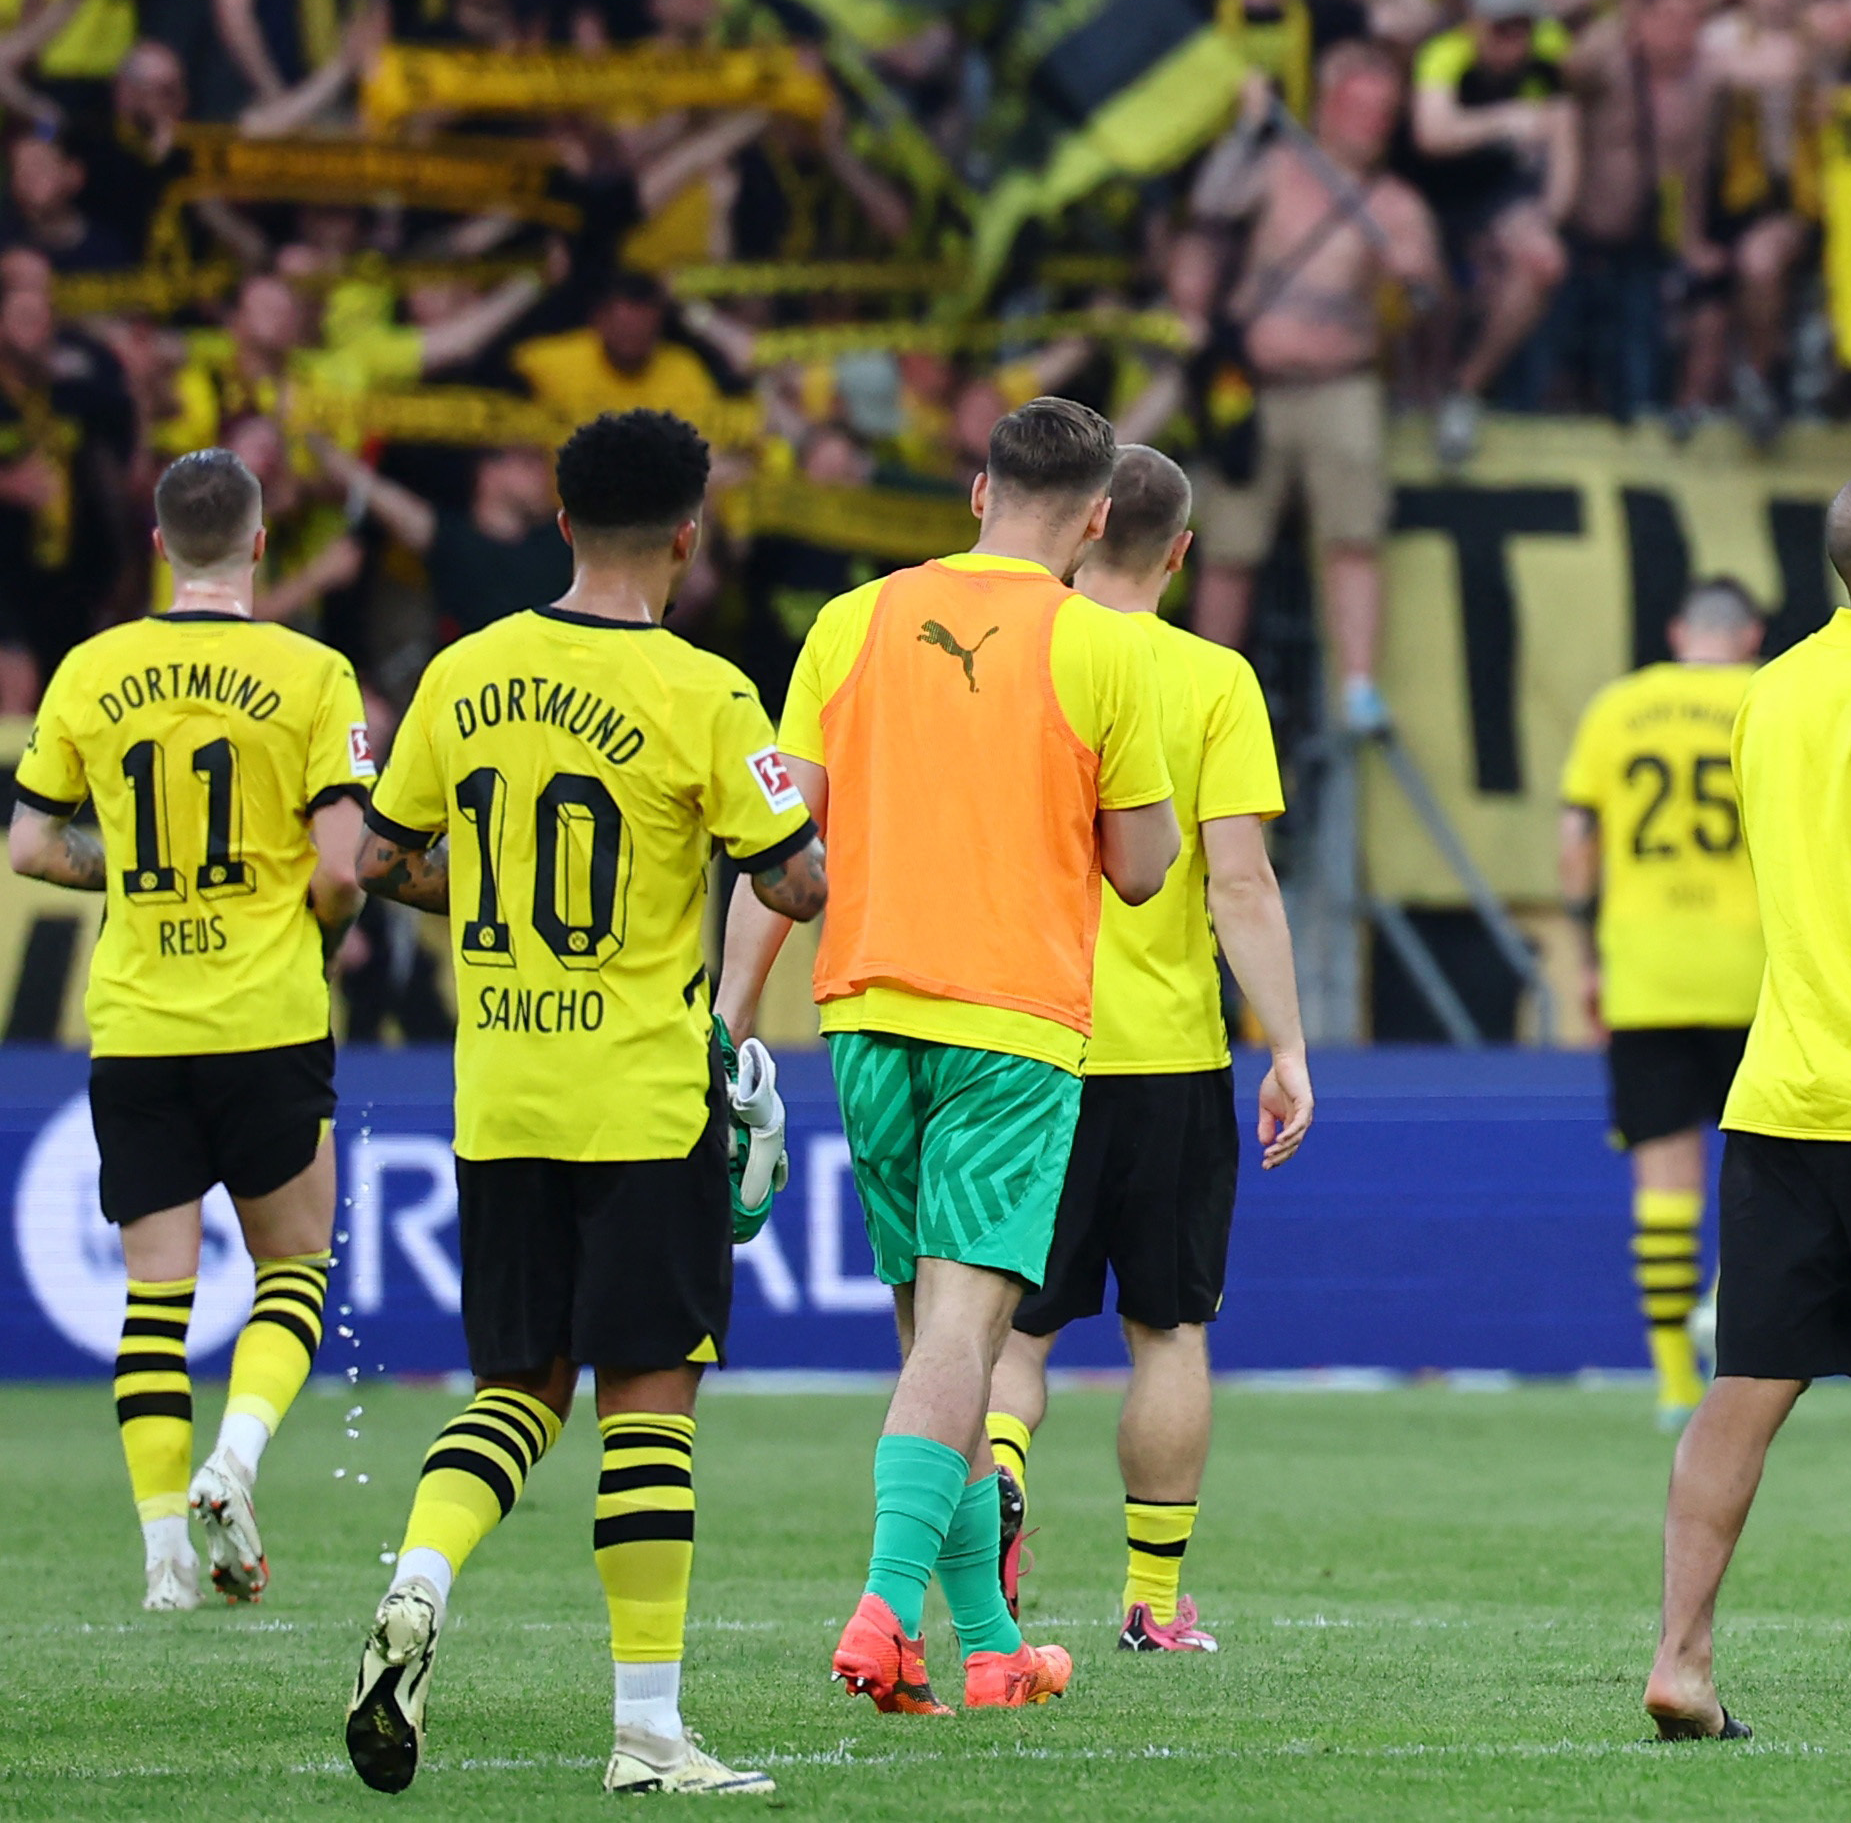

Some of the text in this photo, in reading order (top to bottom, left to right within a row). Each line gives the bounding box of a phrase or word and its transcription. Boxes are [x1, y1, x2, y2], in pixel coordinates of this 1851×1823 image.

[98, 663, 281, 724] DORTMUND
[454, 677, 646, 765] DORTMUND
[122, 737, 256, 907] 11
[1625, 753, 1742, 863] 25
[455, 767, 634, 971] 10
[160, 915, 228, 957] REUS
[477, 986, 606, 1032] SANCHO
